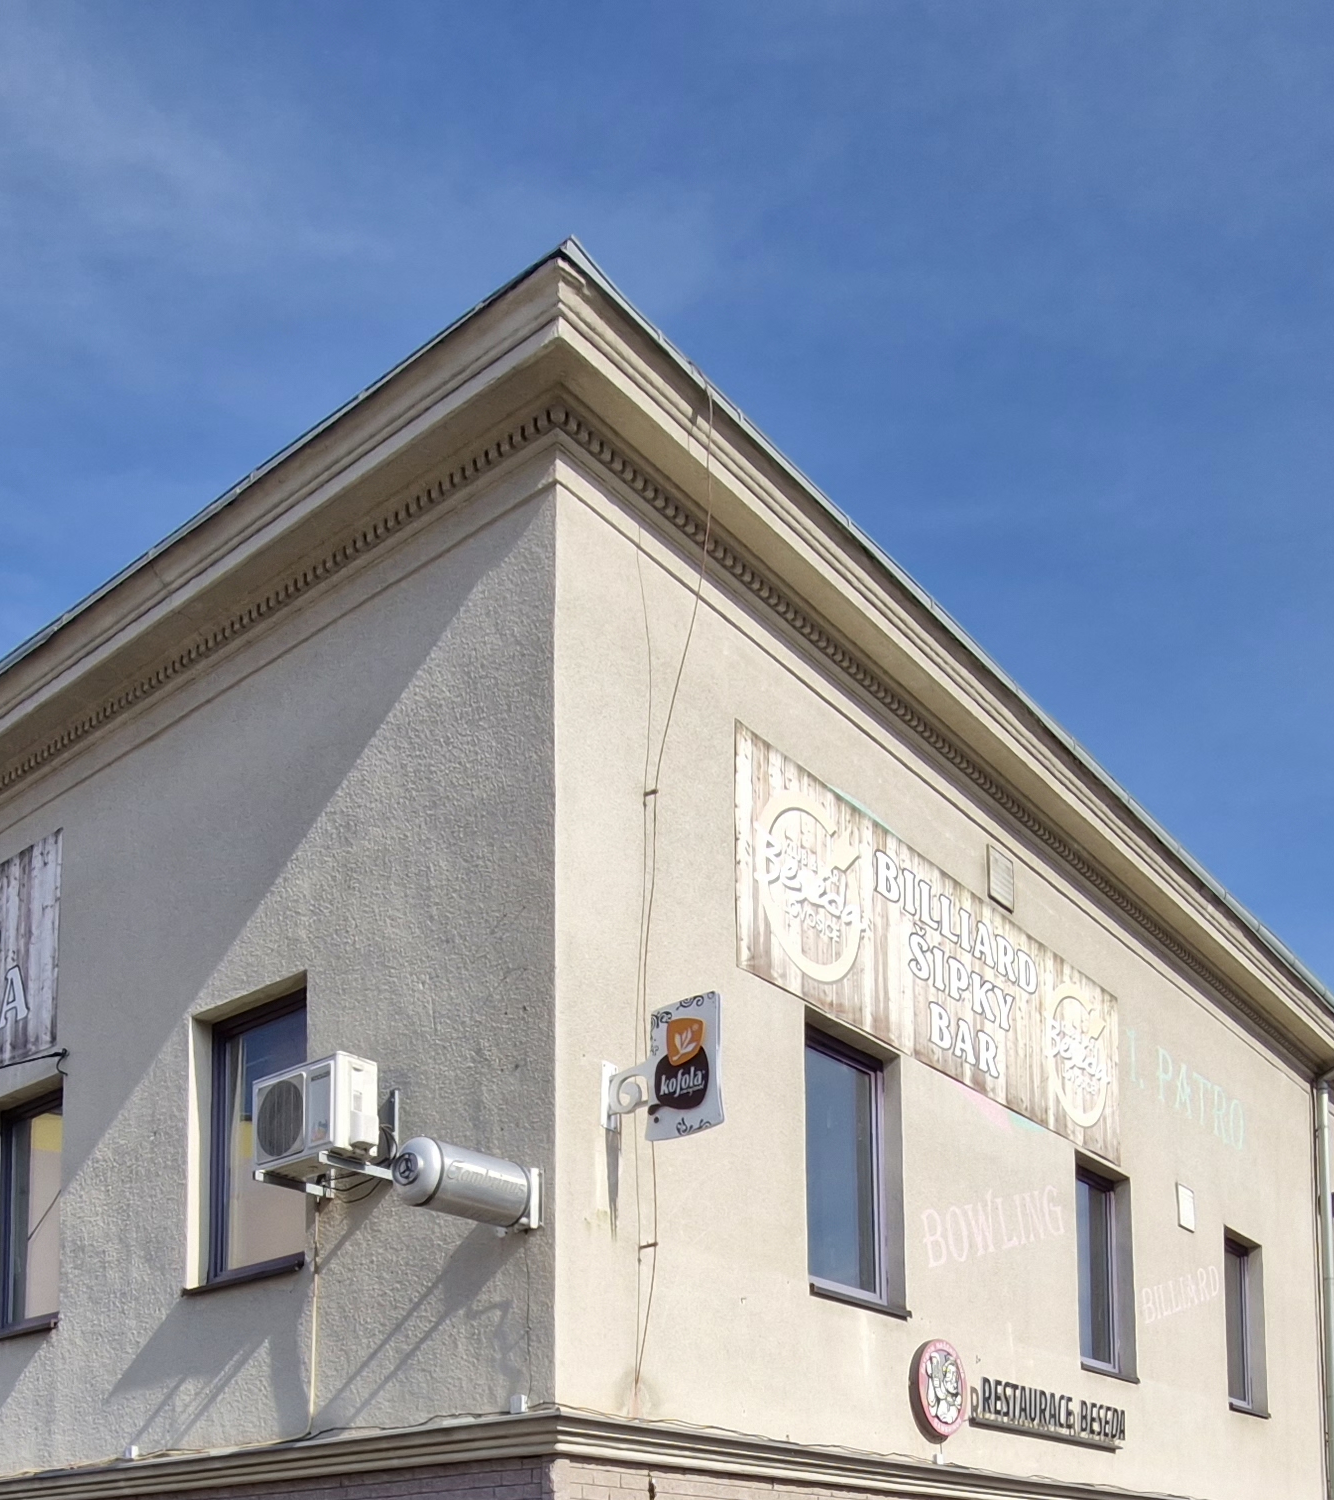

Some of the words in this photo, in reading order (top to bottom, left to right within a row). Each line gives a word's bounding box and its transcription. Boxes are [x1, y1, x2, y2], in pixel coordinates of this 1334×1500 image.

[873, 849, 1039, 996] BILLIARD
[907, 925, 1016, 1033] ŠIPKY
[927, 1001, 1001, 1079] BAR
[659, 1066, 702, 1098] kofola
[1156, 1046, 1244, 1151] PATRO
[920, 1184, 1066, 1268] BOWLING
[1142, 1265, 1221, 1324] BILLIARD
[982, 1376, 1073, 1429] RESTAURACE
[1079, 1399, 1126, 1441] BESEDA
